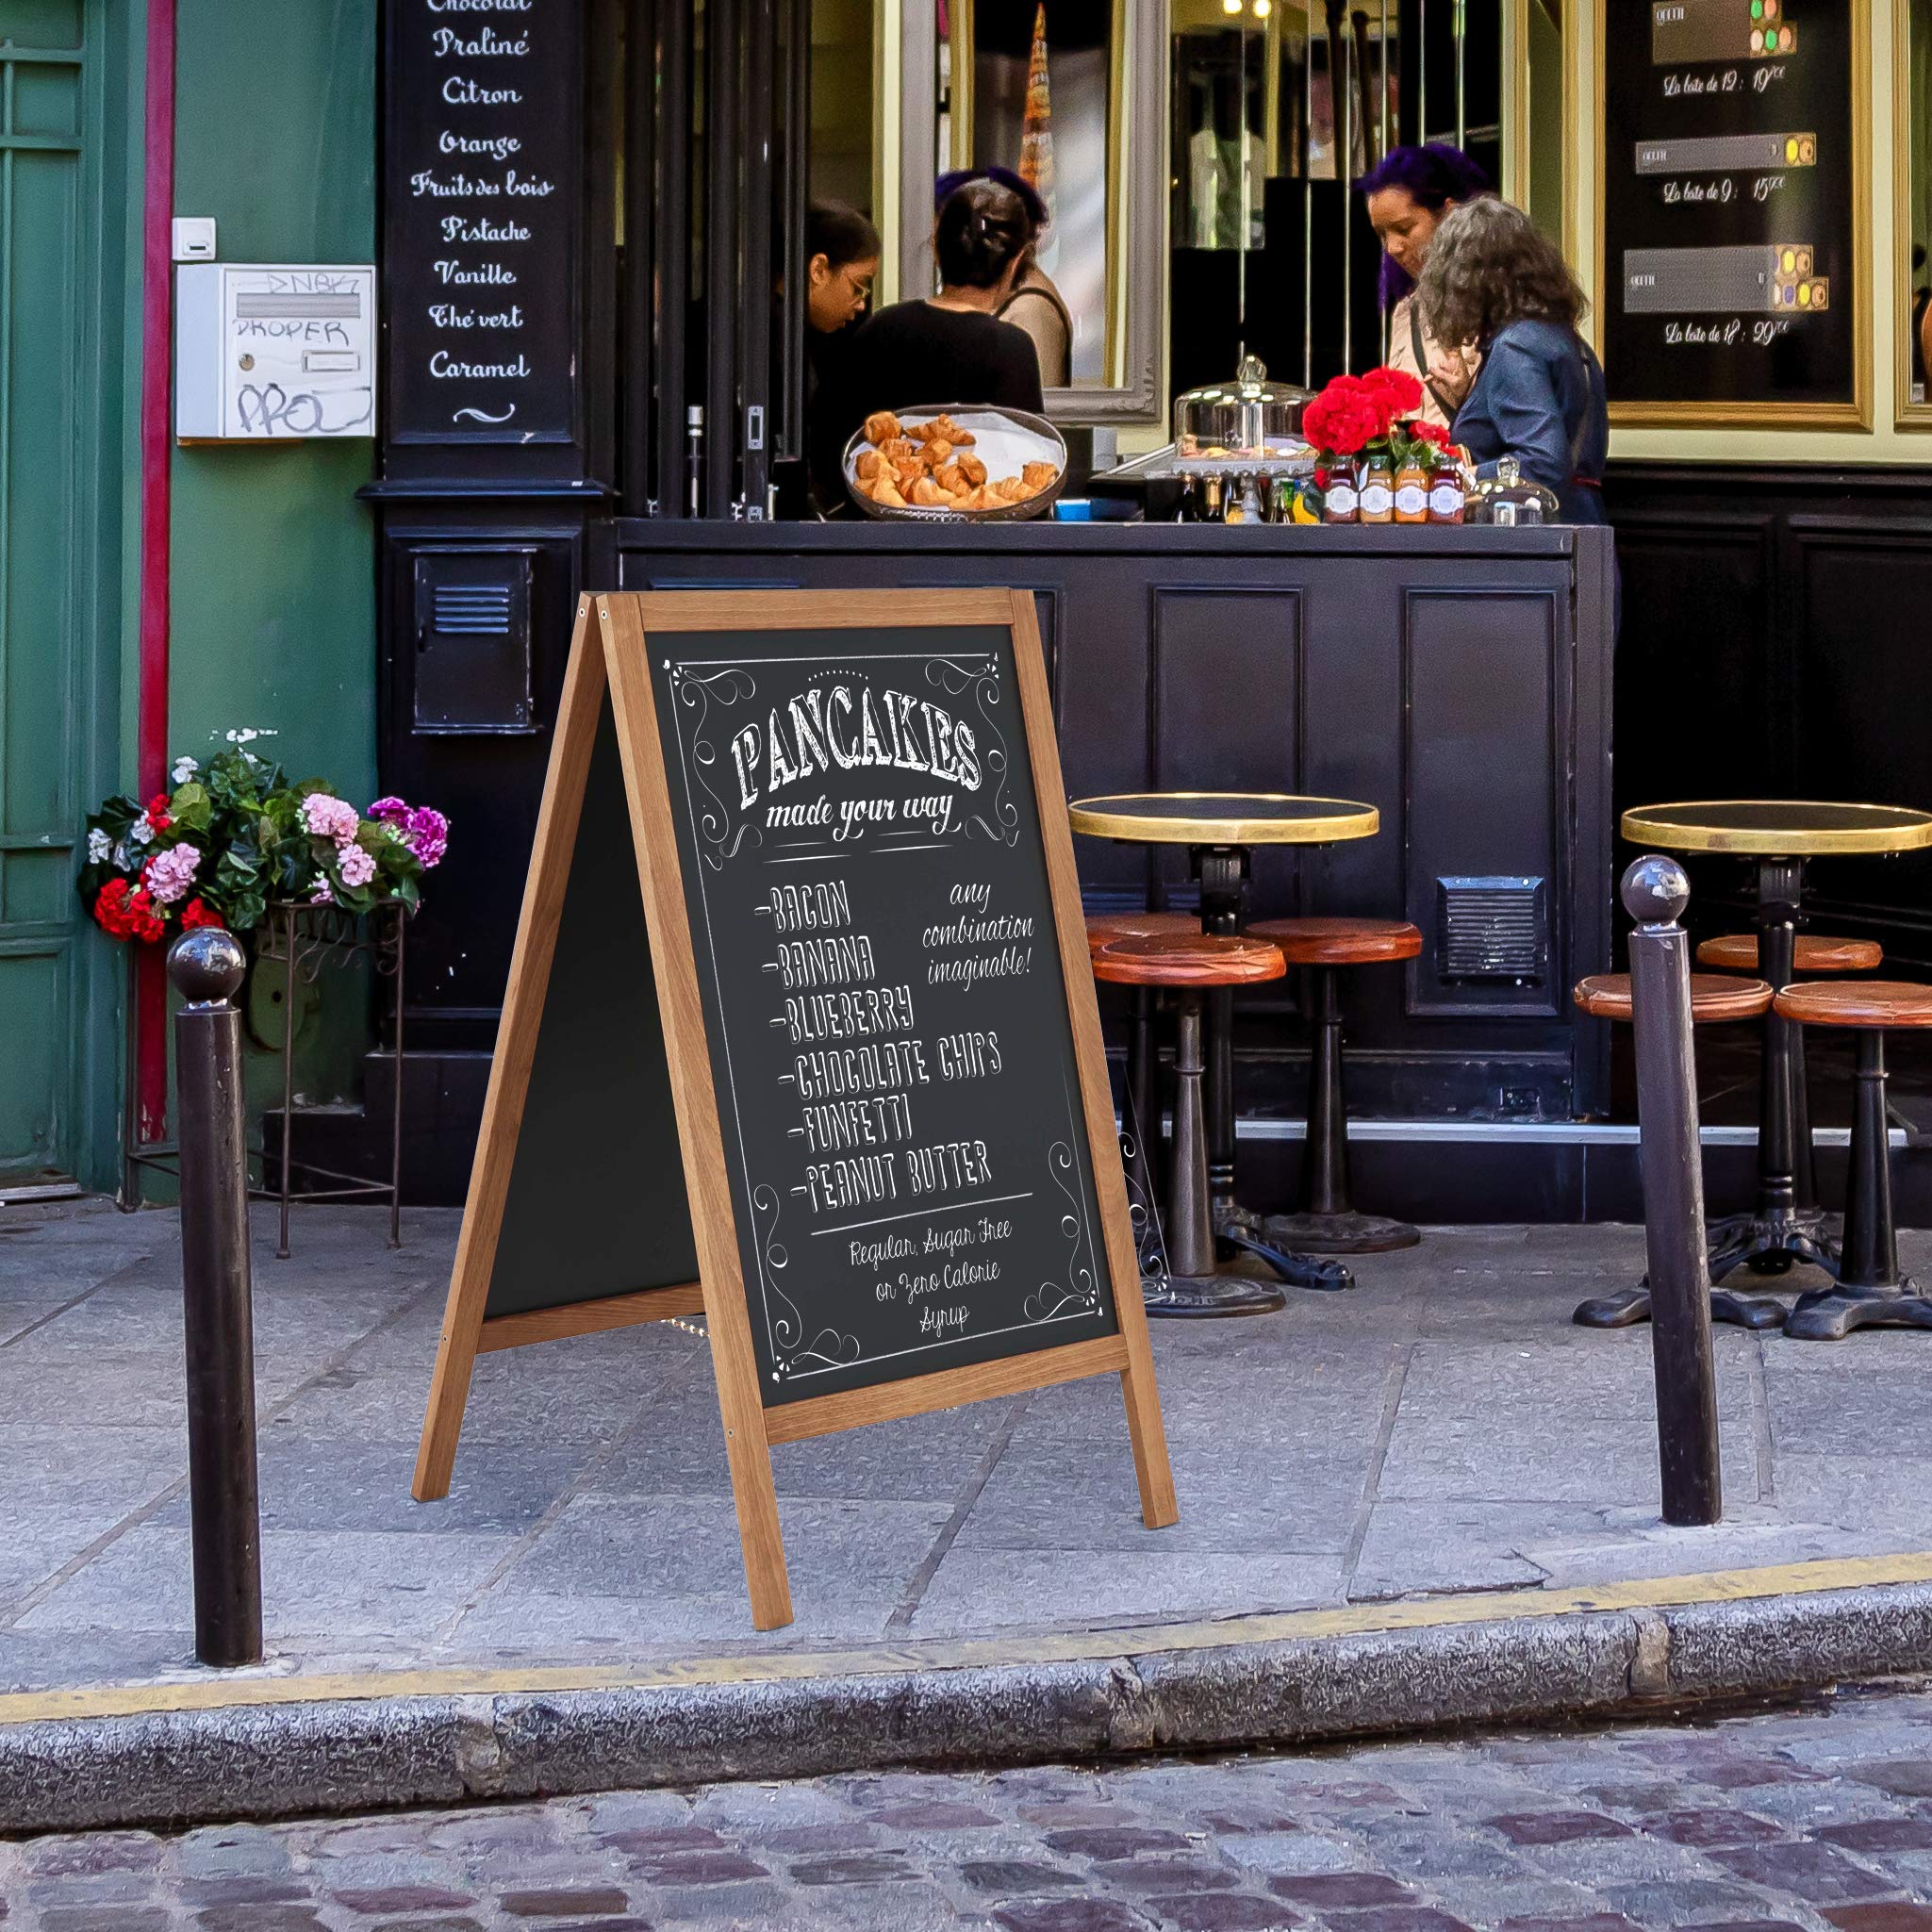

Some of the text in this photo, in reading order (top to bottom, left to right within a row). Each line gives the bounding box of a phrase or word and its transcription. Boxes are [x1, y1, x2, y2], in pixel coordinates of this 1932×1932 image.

[432, 26, 530, 58] Praliné
[442, 75, 522, 105] Citron
[1706, 74, 1719, 92] de
[438, 130, 521, 161] Orange
[410, 169, 554, 197] Fruits des bois
[1706, 181, 1720, 201] de
[440, 215, 532, 242] Pistache
[433, 259, 517, 285] Vanille
[428, 304, 523, 328] Thé vert
[1708, 323, 1721, 343] de
[429, 350, 531, 378] Caramel
[731, 686, 983, 810] PANCAKES
[766, 794, 962, 841] made your way
[949, 883, 991, 914] any
[922, 916, 1034, 948] combination
[928, 946, 1032, 991] imaginable!
[936, 1032, 1001, 1081] CHIPS
[906, 1140, 991, 1196] BUTTER
[922, 1227, 976, 1258] Sugar
[977, 1216, 1013, 1244] Free
[875, 1260, 1000, 1304] or Zero Calorie
[919, 1306, 970, 1337] Syrup
